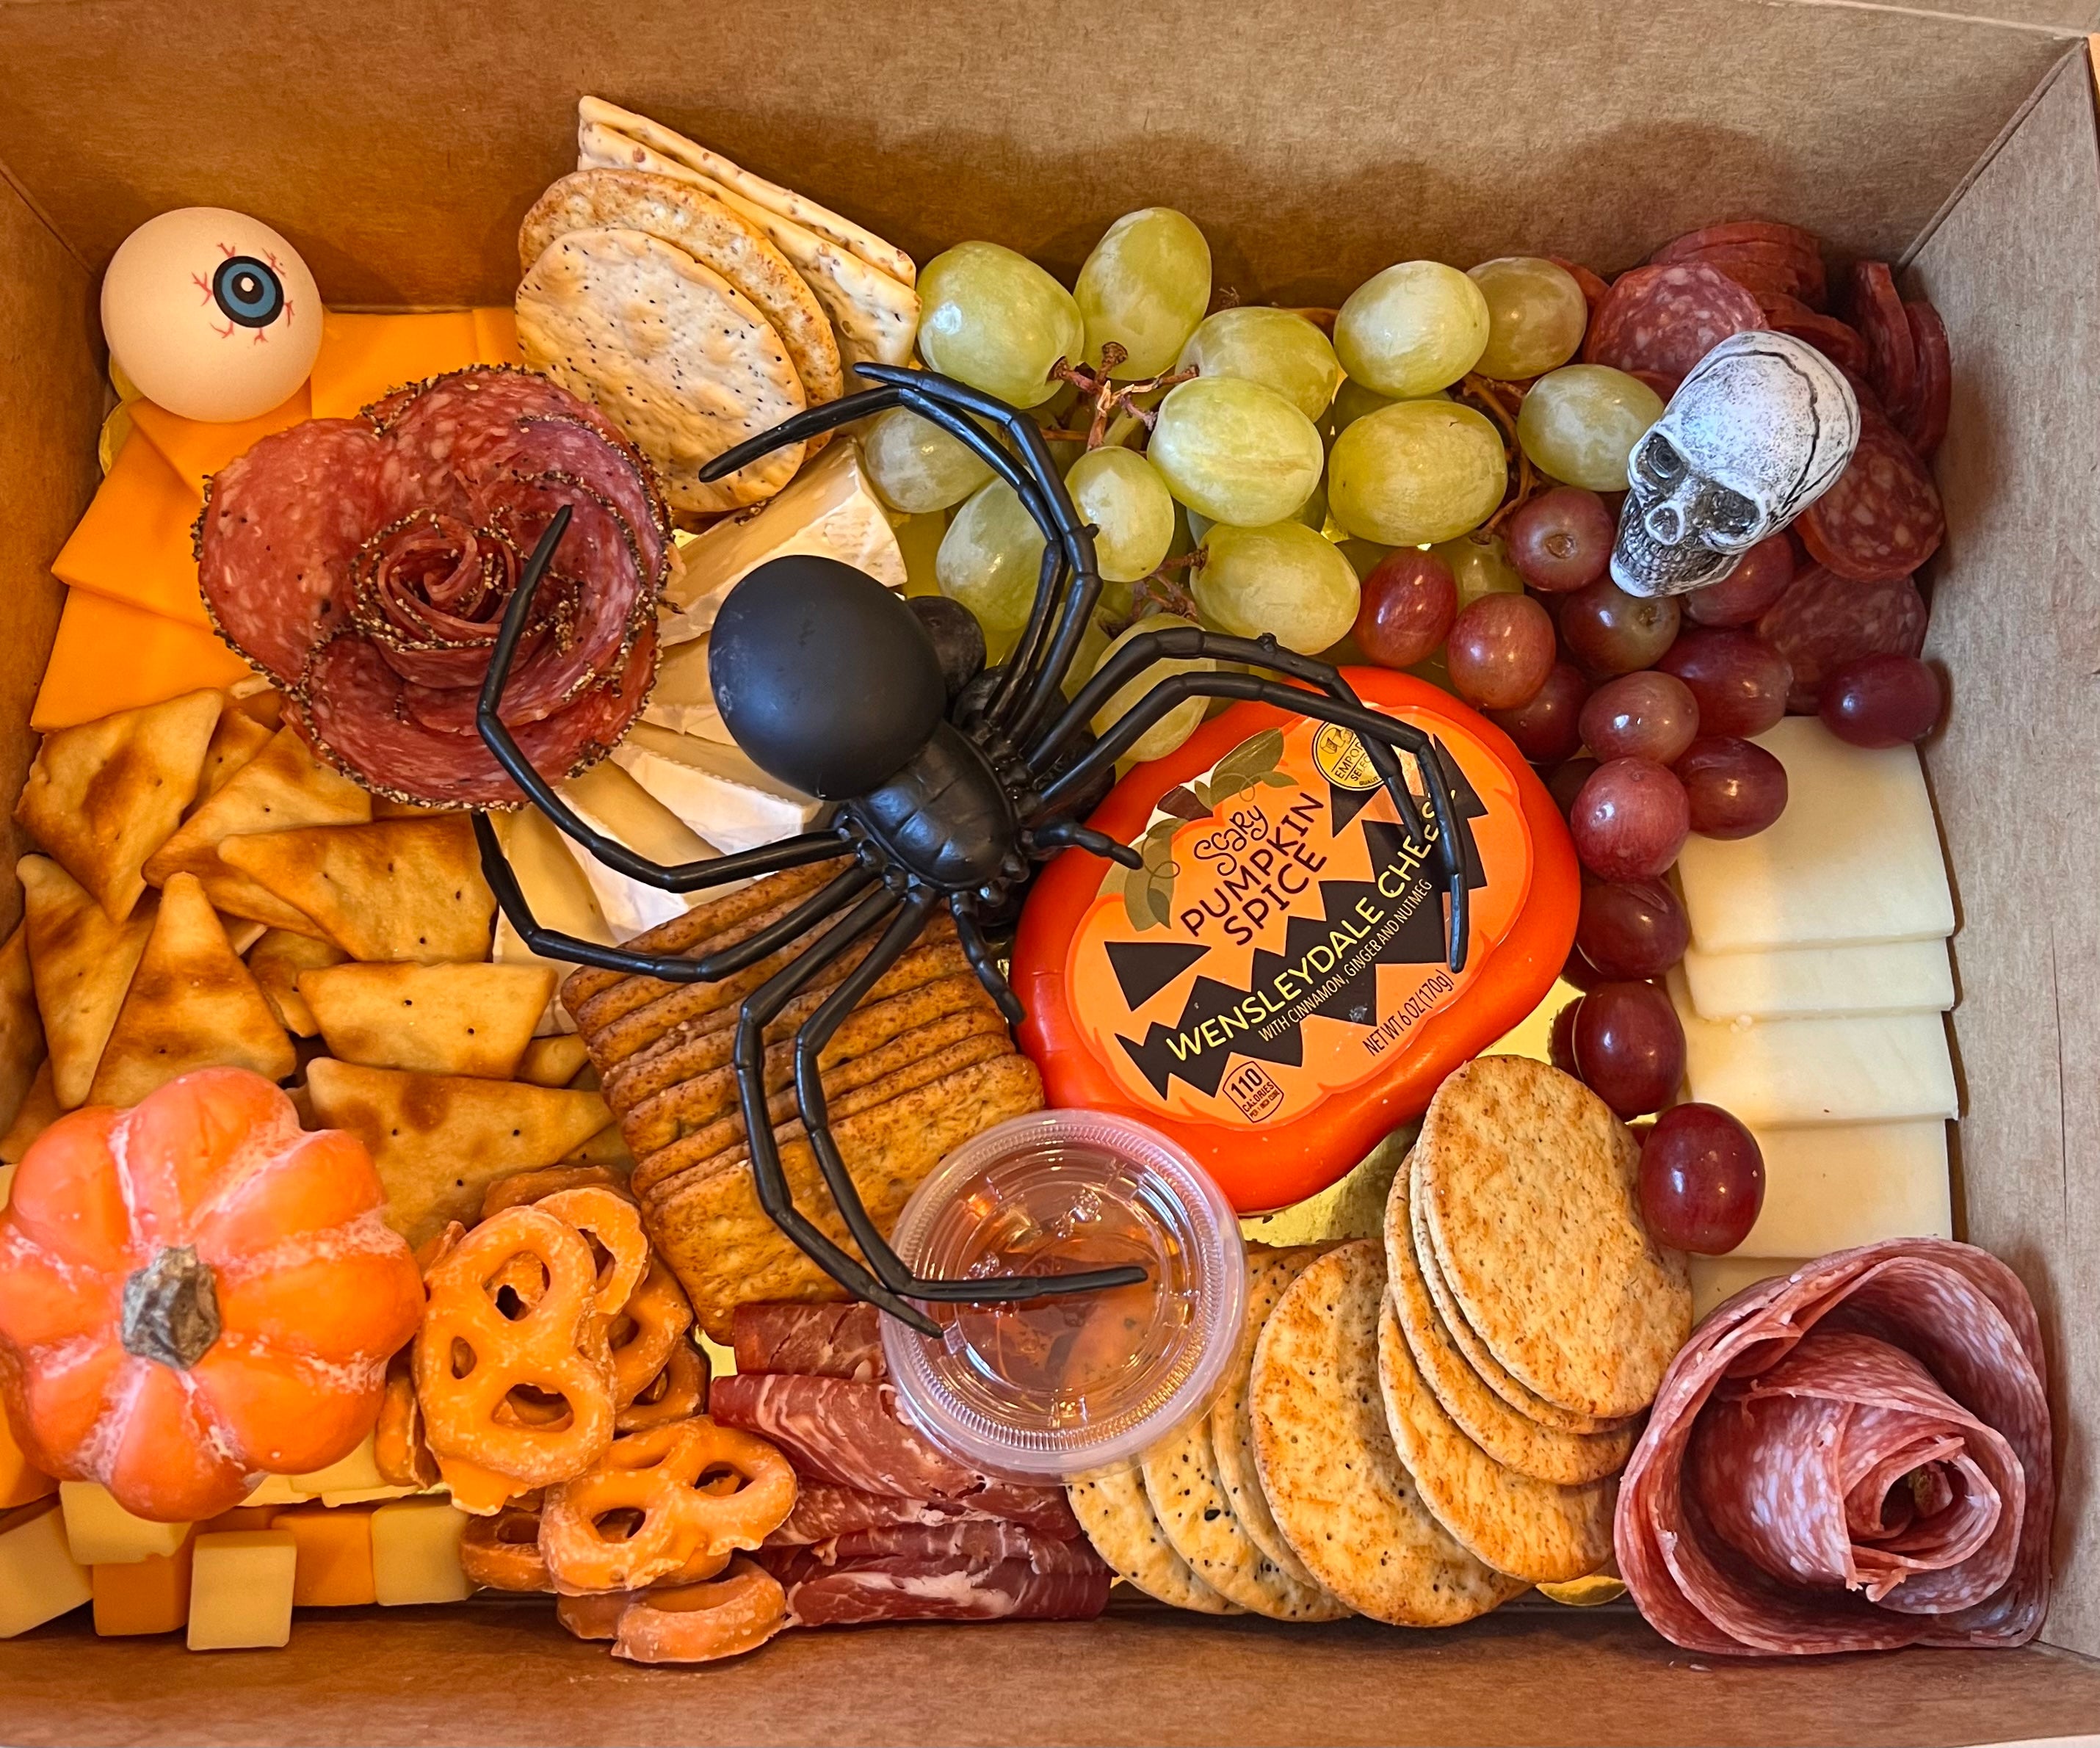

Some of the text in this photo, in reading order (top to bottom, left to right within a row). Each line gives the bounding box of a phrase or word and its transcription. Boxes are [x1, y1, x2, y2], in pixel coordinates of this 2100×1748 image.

[1180, 792, 1324, 937] PUMPKIN
[1223, 843, 1327, 946] SPICE
[1166, 897, 1384, 1061] WENSLEYDALE
[1258, 878, 1433, 1042] WITH CINNAMON, GINGER AND NUTMEG
[1231, 1068, 1263, 1100] 110
[1363, 1025, 1385, 1056] NET
[1380, 1015, 1401, 1040] WT
[1397, 1010, 1412, 1026] 6
[1242, 1081, 1275, 1112] CALORIES
